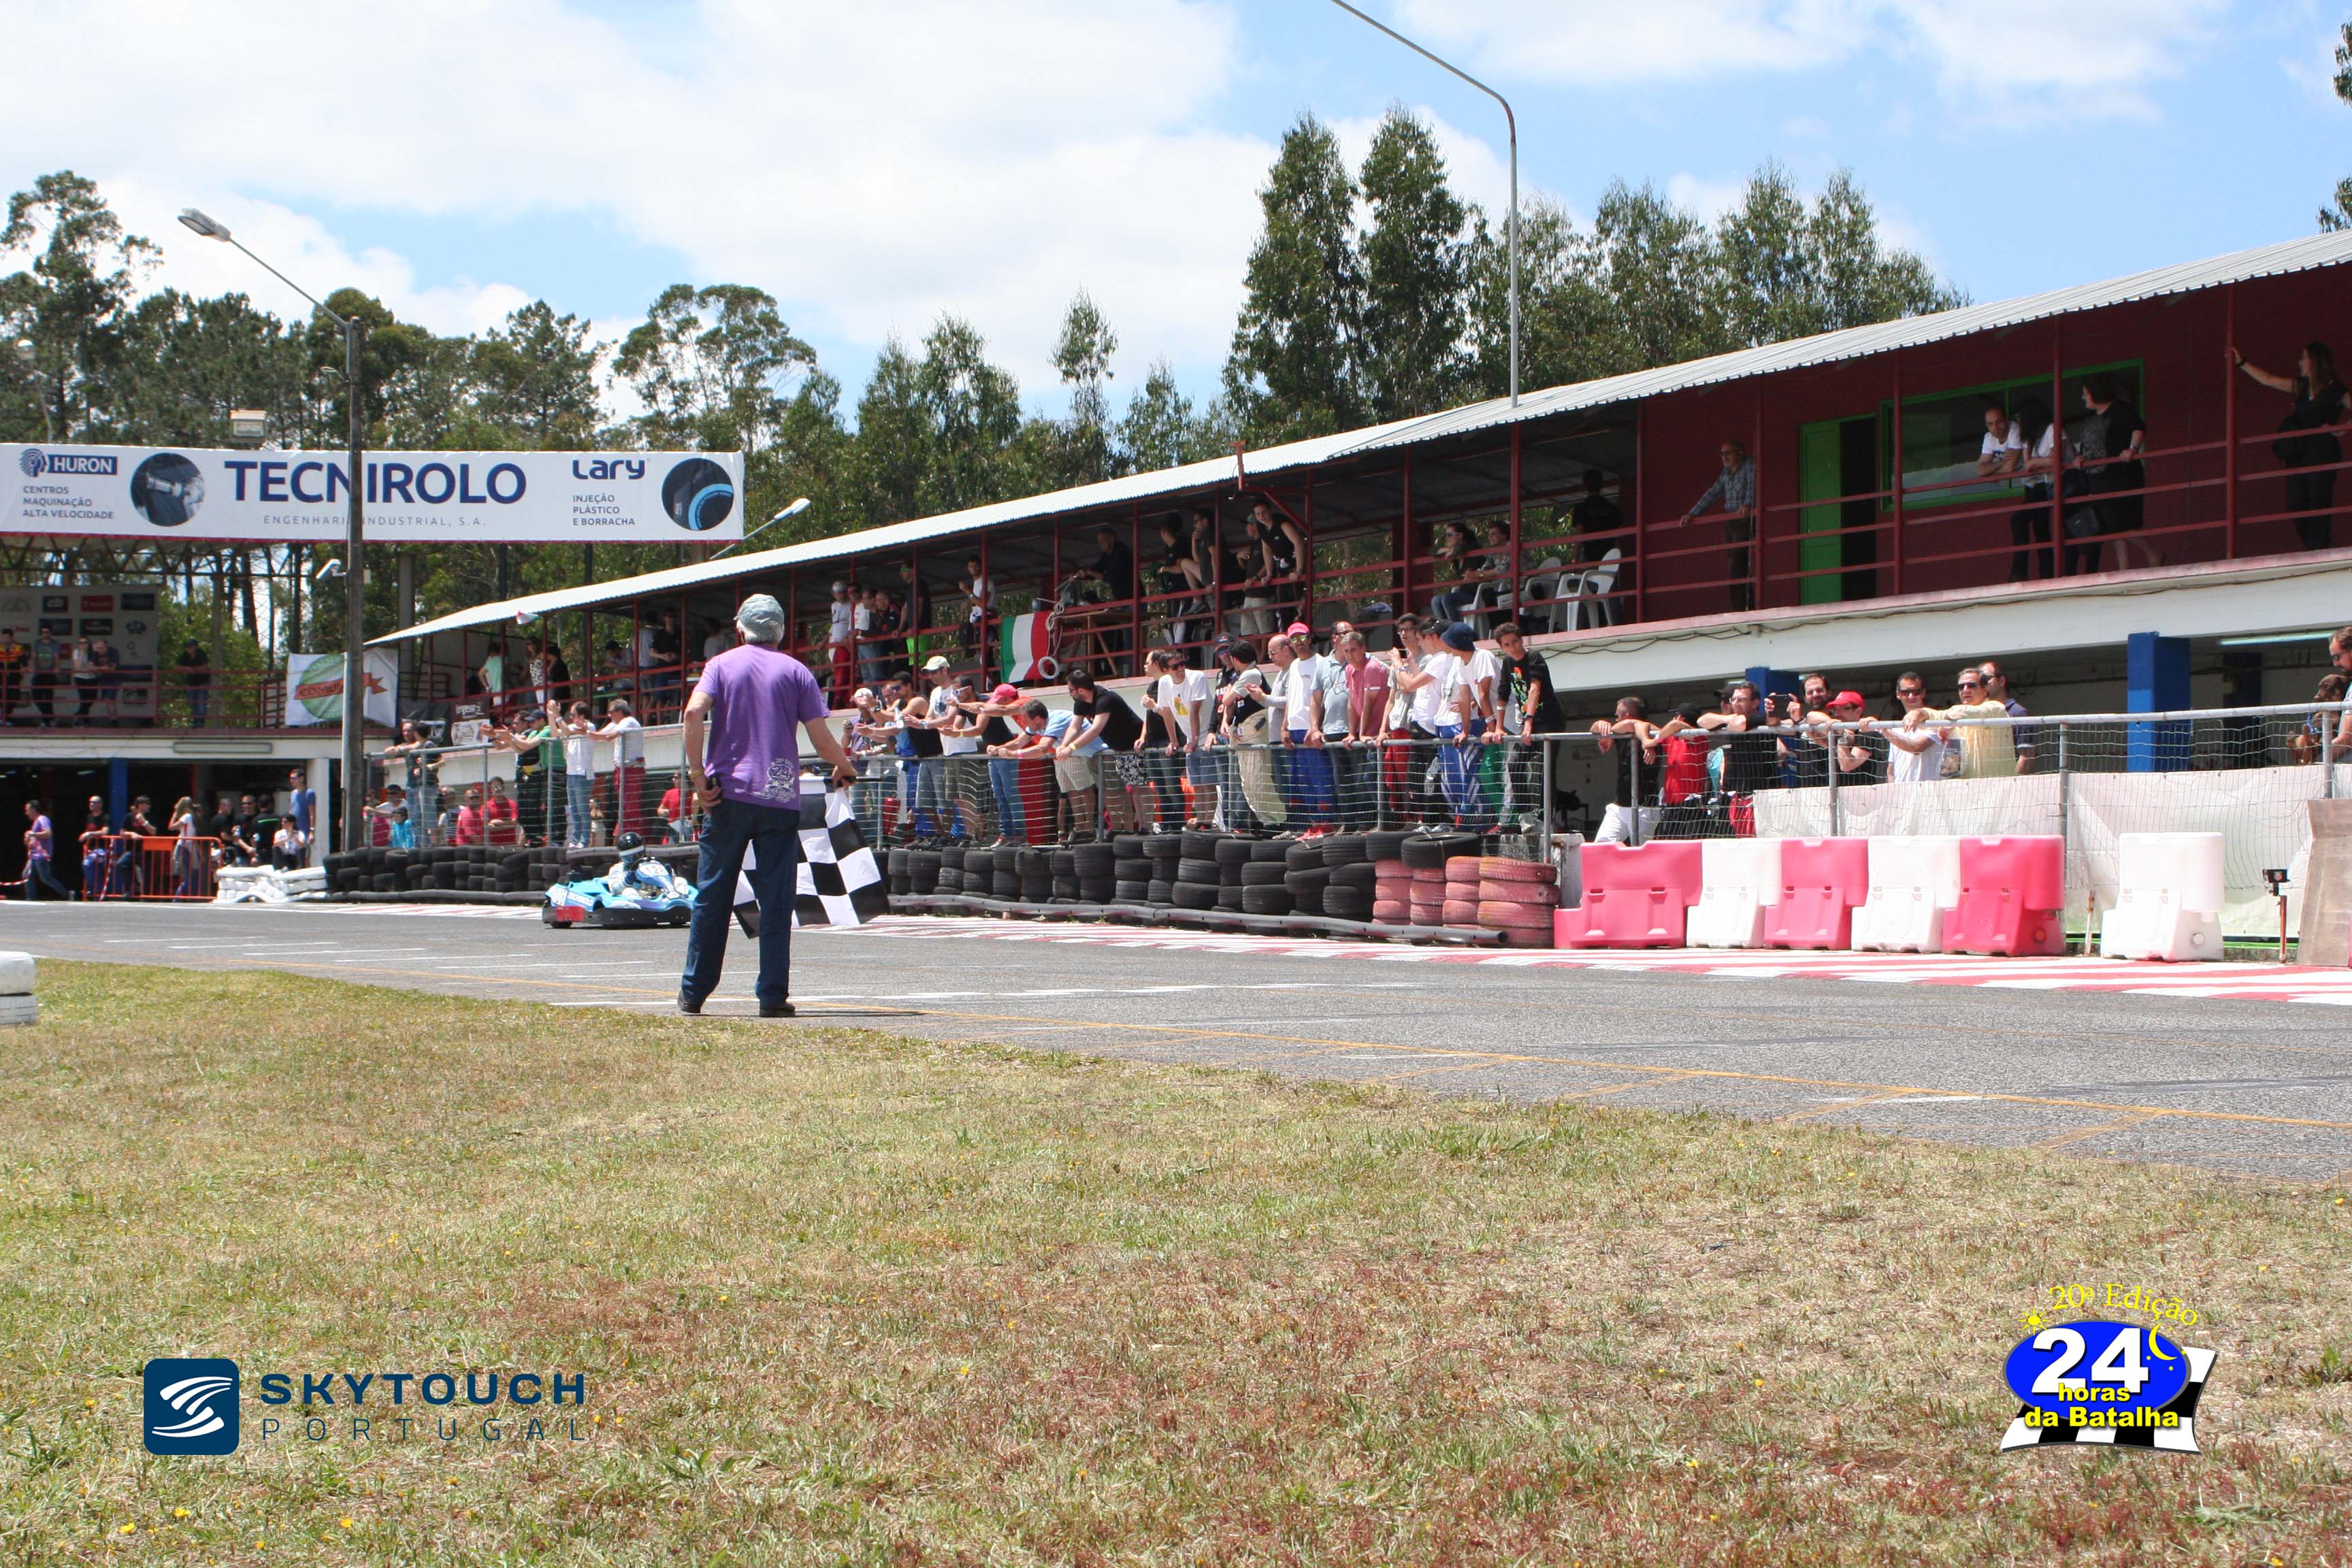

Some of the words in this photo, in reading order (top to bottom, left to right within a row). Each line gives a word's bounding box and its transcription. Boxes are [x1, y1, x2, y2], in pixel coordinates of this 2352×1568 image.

[54, 457, 112, 473] HURON
[224, 461, 527, 504] TECNIROLO
[22, 485, 69, 495] CENTROS
[22, 497, 93, 508] MAQUINAÇÃO
[573, 493, 615, 504] INJEÇÃO
[22, 508, 49, 518] ALTA
[50, 510, 114, 519] VELOCIDADE
[573, 504, 620, 514] PLÁSTICO
[263, 514, 351, 525] ENGENHARI
[573, 518, 578, 526] E
[581, 518, 636, 526] BORRACHA
